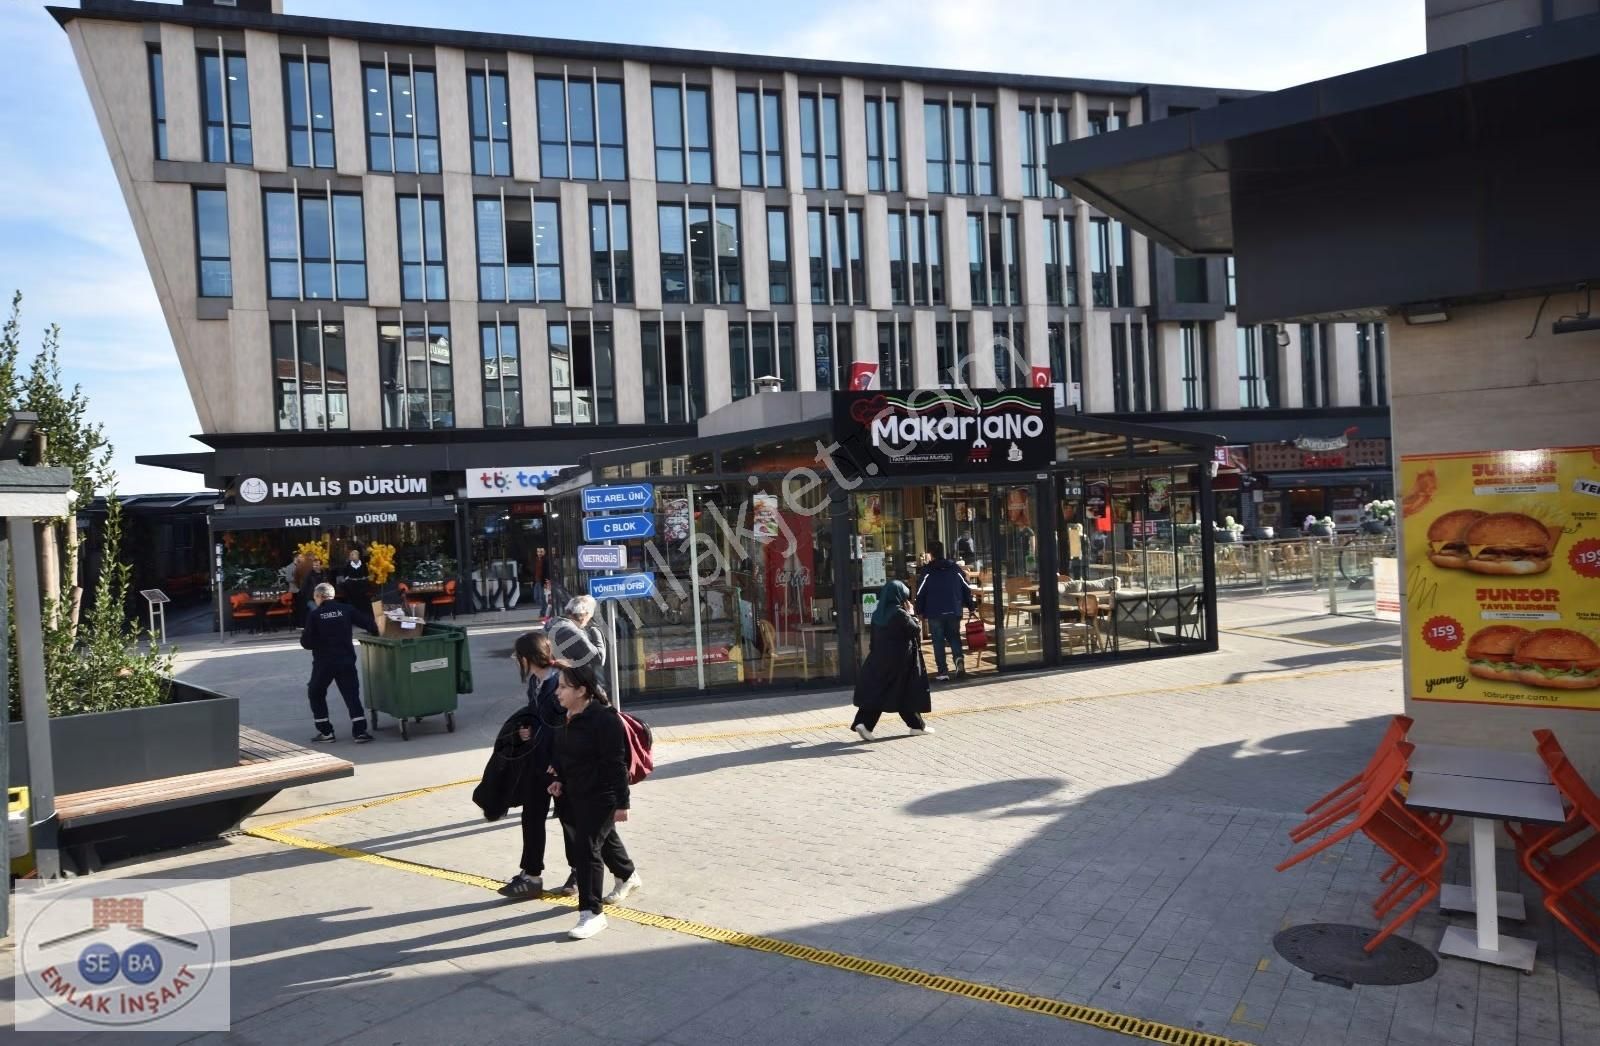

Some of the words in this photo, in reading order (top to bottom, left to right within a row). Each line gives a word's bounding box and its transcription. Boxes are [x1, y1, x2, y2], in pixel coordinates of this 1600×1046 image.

[272, 477, 341, 497] HALİS
[349, 475, 427, 495] DÜRÜM
[587, 494, 603, 504] İST.
[604, 492, 627, 503] AREL
[629, 490, 646, 501] ÜNİ.
[285, 516, 320, 527] HALİS
[355, 512, 397, 524] DÜRÜM
[603, 524, 611, 533] C
[612, 522, 636, 532] BLOK
[583, 553, 617, 564] METROBÜS
[593, 583, 625, 594] YÖNETİM
[626, 581, 645, 592] OFİSİ
[1476, 588, 1560, 602] JUNIOR
[1515, 603, 1557, 611] BURGER
[1431, 624, 1456, 638] 159
[1425, 675, 1469, 693] yummy
[1483, 691, 1559, 702] 10burger.com.tr
